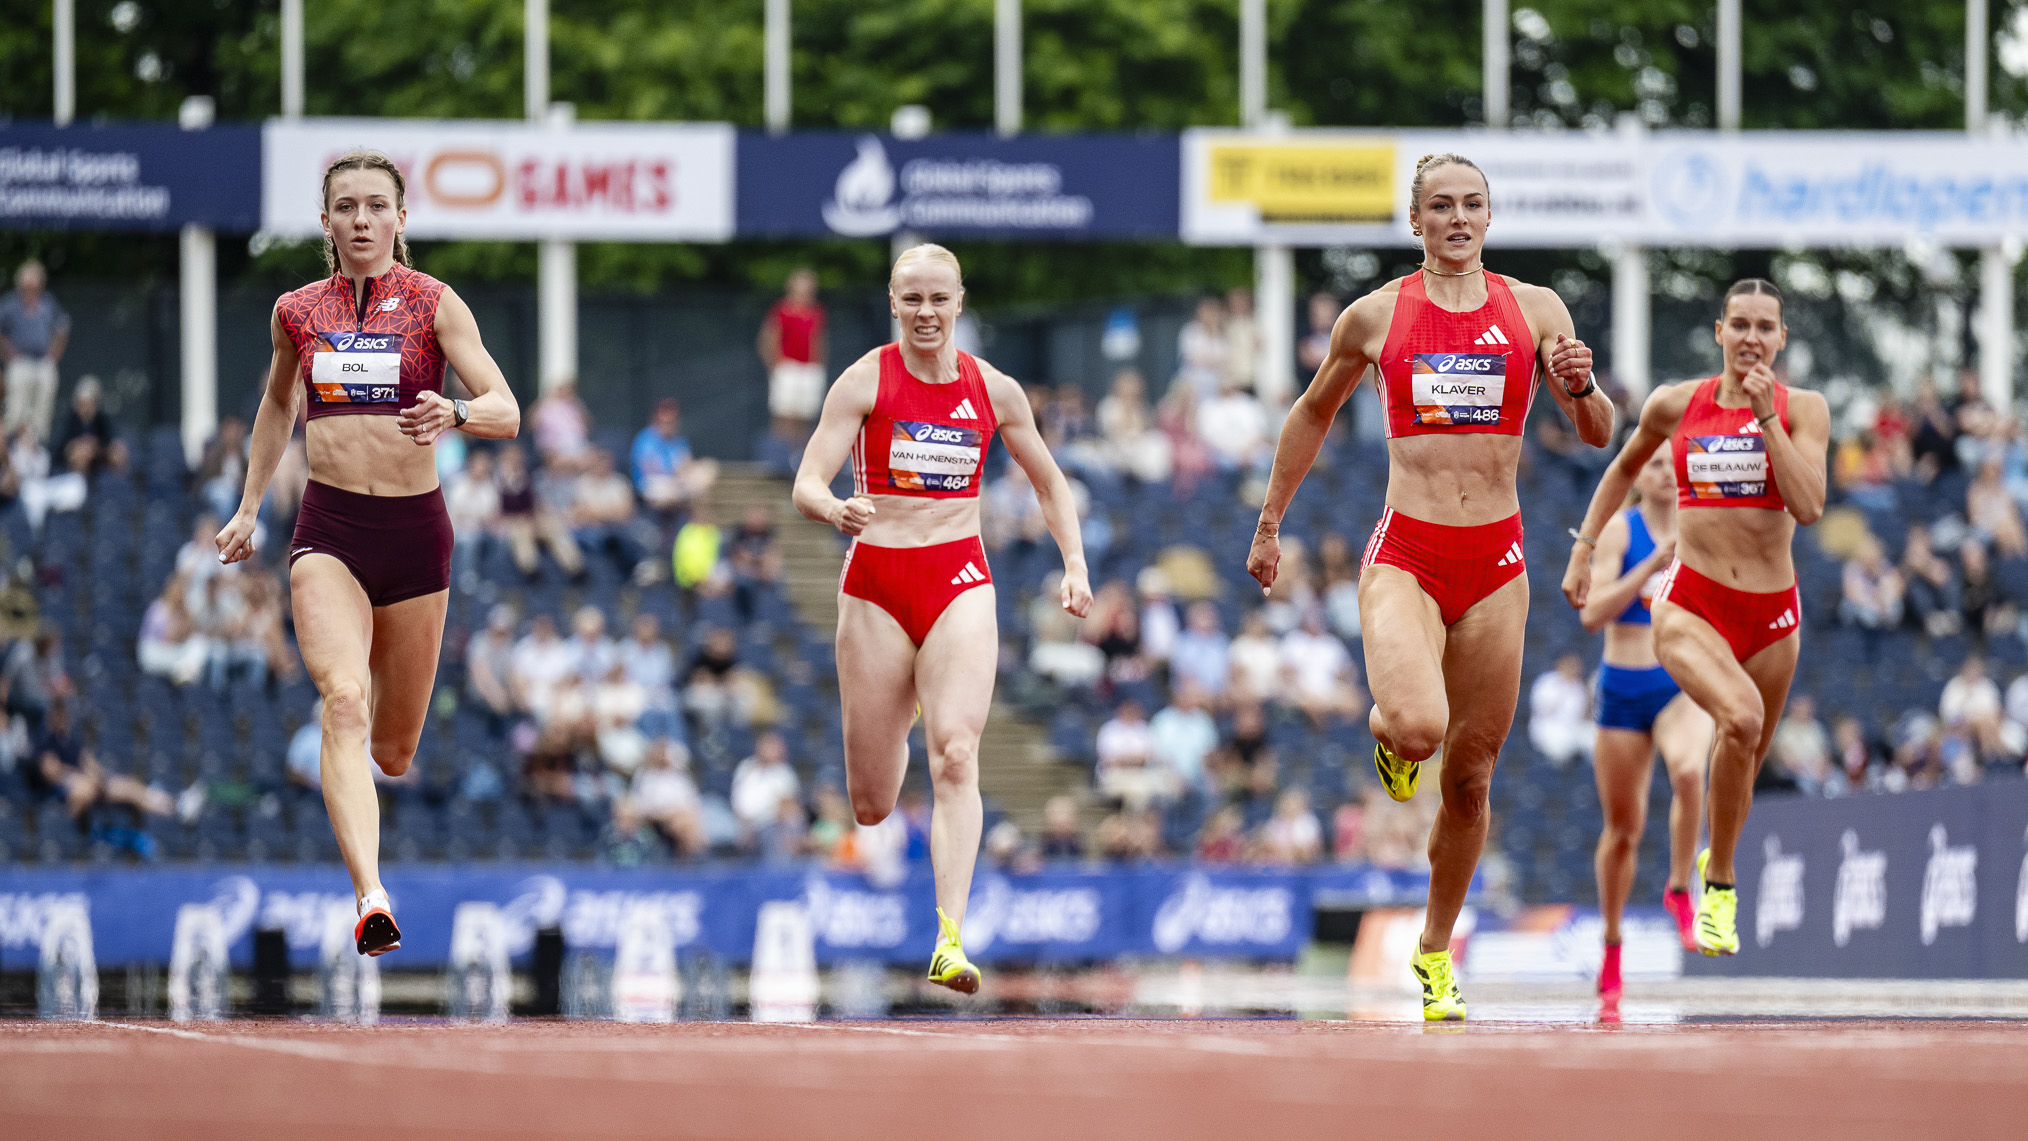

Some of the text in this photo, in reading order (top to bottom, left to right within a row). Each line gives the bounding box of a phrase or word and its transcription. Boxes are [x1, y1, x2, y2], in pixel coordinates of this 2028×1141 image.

[518, 160, 673, 211] GAMES
[342, 363, 368, 372] BOL
[372, 388, 394, 398] 371
[1432, 385, 1485, 395] KLAVER
[1473, 409, 1499, 421] 486
[892, 451, 978, 465] VAN HUNENSTIJN
[1692, 463, 1761, 472] DE BLAAUW
[943, 476, 970, 490] 464
[1741, 483, 1764, 494] 367
